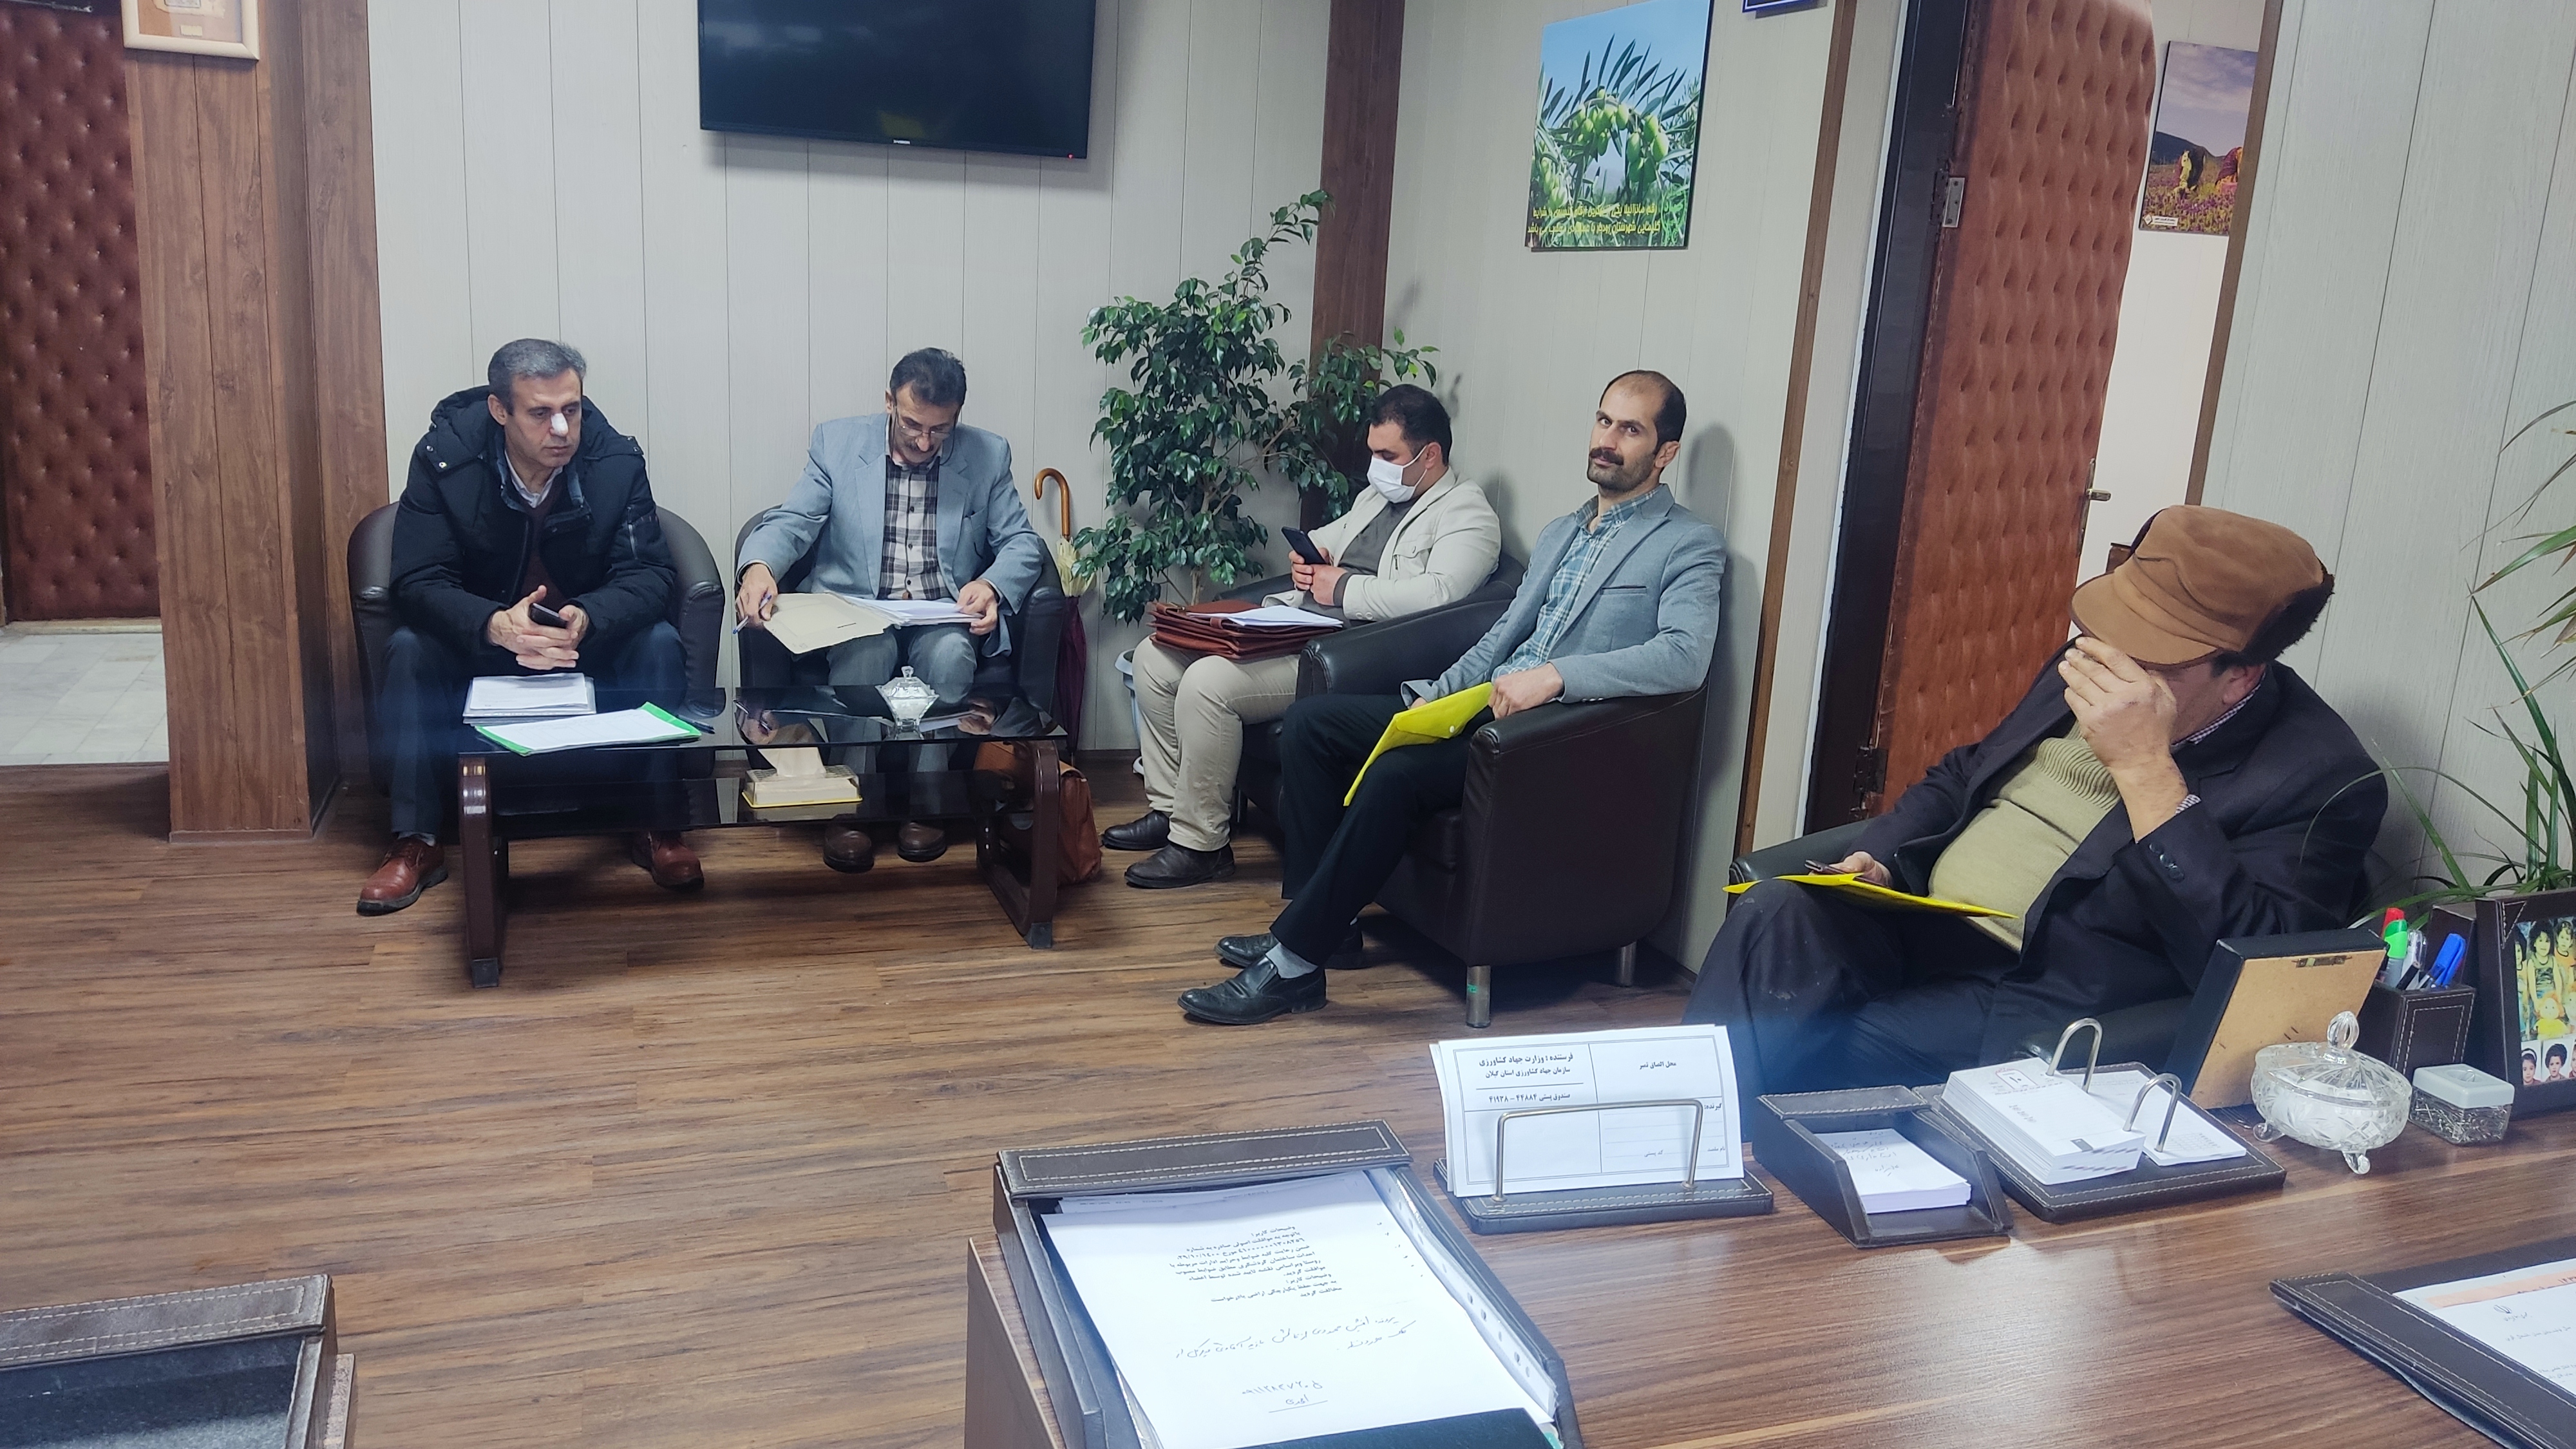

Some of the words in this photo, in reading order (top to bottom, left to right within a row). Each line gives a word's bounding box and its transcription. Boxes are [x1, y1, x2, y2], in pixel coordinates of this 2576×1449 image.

[1479, 1056, 1506, 1066] کشاورزی
[1525, 1055, 1544, 1064] وزارت
[1549, 1052, 1573, 1062] فرستنده
[1515, 1068, 1538, 1077] کشاورزی
